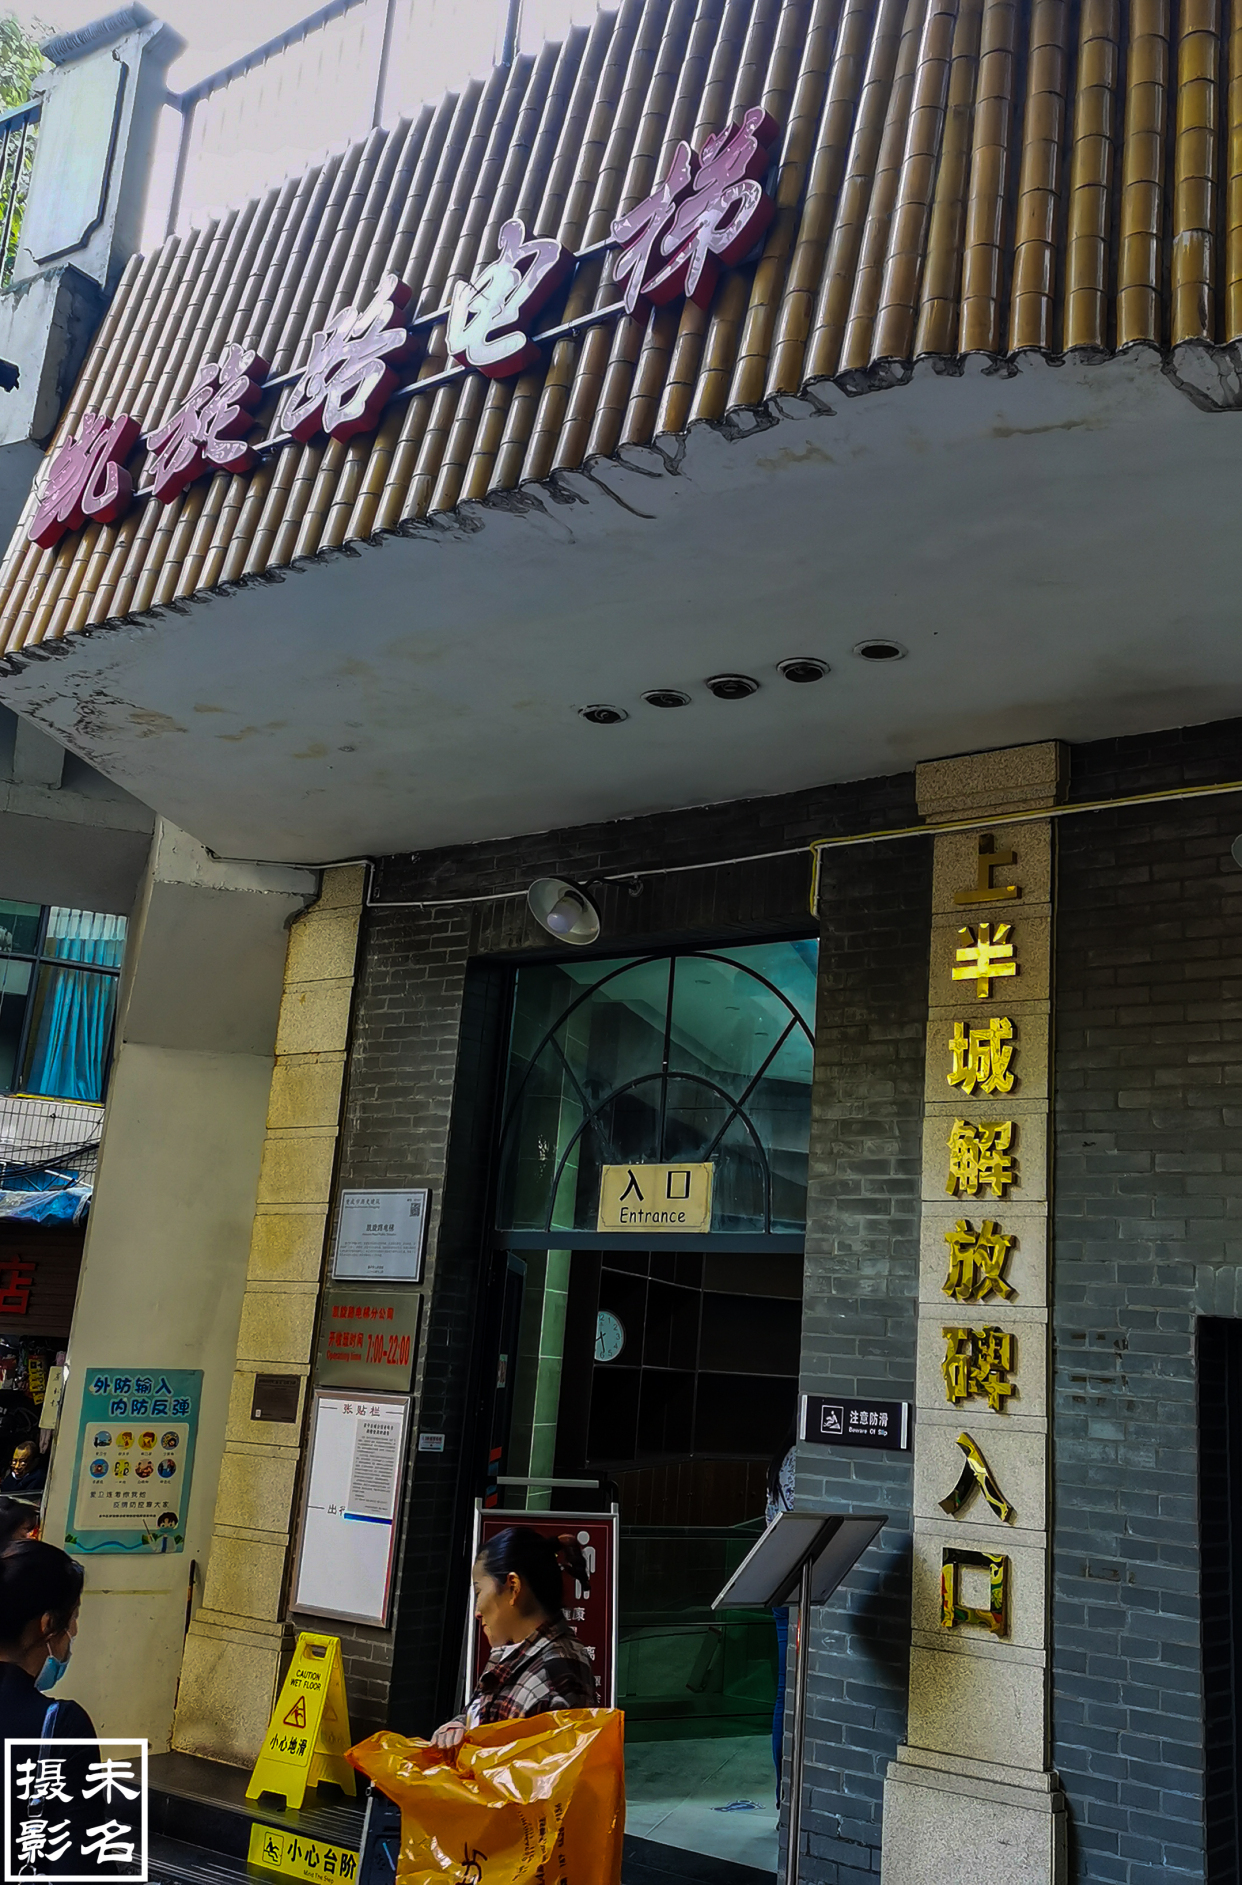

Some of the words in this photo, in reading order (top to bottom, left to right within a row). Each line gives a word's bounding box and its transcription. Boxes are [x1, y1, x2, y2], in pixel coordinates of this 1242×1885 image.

[27, 106, 780, 550] 凯旋路电梯
[619, 1169, 691, 1201] 入口
[620, 1207, 686, 1223] Entrance
[938, 833, 1021, 1640] 上半城解放碑入口
[94, 1376, 172, 1395] 外防输入
[110, 1398, 190, 1416] 内防反弹
[343, 1403, 380, 1416] 张贴栏
[849, 1410, 888, 1427] 注意防滑
[296, 1670, 321, 1681] CAUTION
[290, 1679, 302, 1687] WET
[303, 1681, 321, 1691] FLOOR
[270, 1733, 307, 1756] 小心地滑
[287, 1838, 357, 1880] 小心台阶
